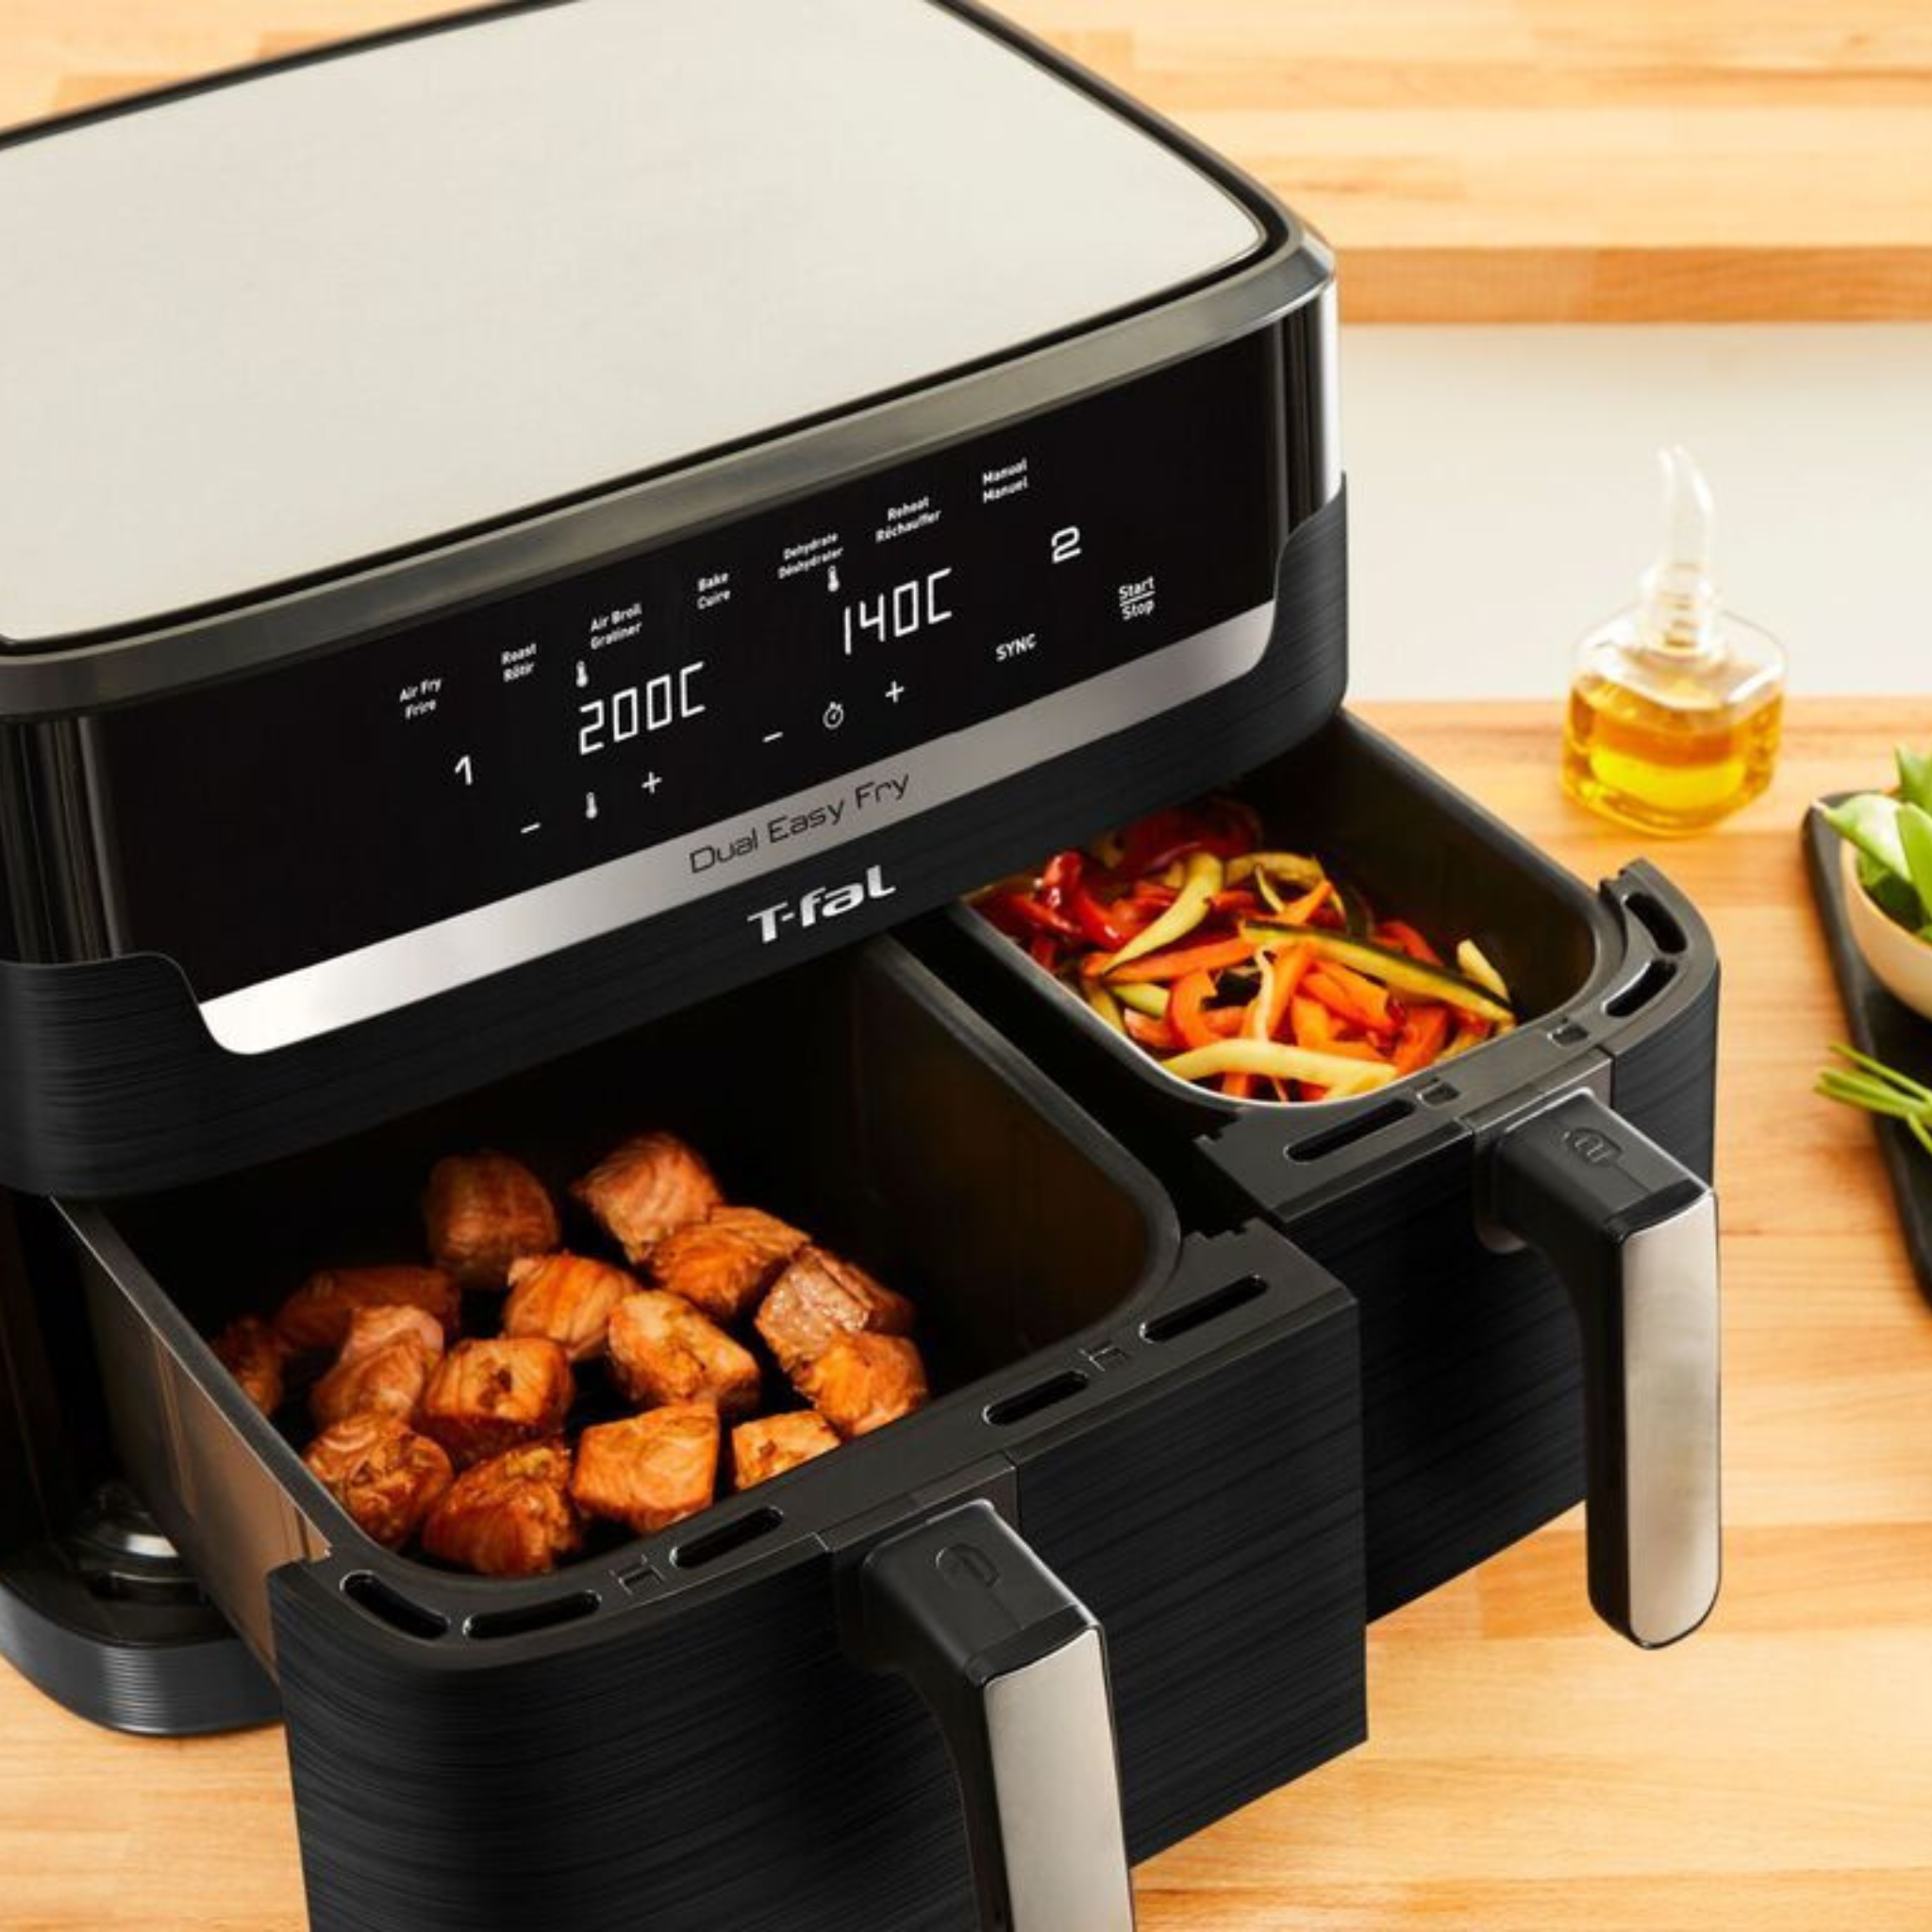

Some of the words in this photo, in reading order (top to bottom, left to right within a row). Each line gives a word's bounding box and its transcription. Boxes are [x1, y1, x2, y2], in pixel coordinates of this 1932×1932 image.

[983, 457, 1028, 486] Manual
[1051, 525, 1082, 564] 2
[1119, 575, 1155, 600] Start
[1122, 599, 1155, 621] Stop
[591, 617, 609, 633] Air
[995, 633, 1037, 661] SYNC
[399, 686, 418, 702] Air
[420, 678, 441, 695] Fry
[579, 661, 706, 755] 200C
[455, 755, 473, 785] 1
[689, 827, 758, 874] Dual
[767, 800, 844, 843] Easy
[854, 774, 909, 808] Fry
